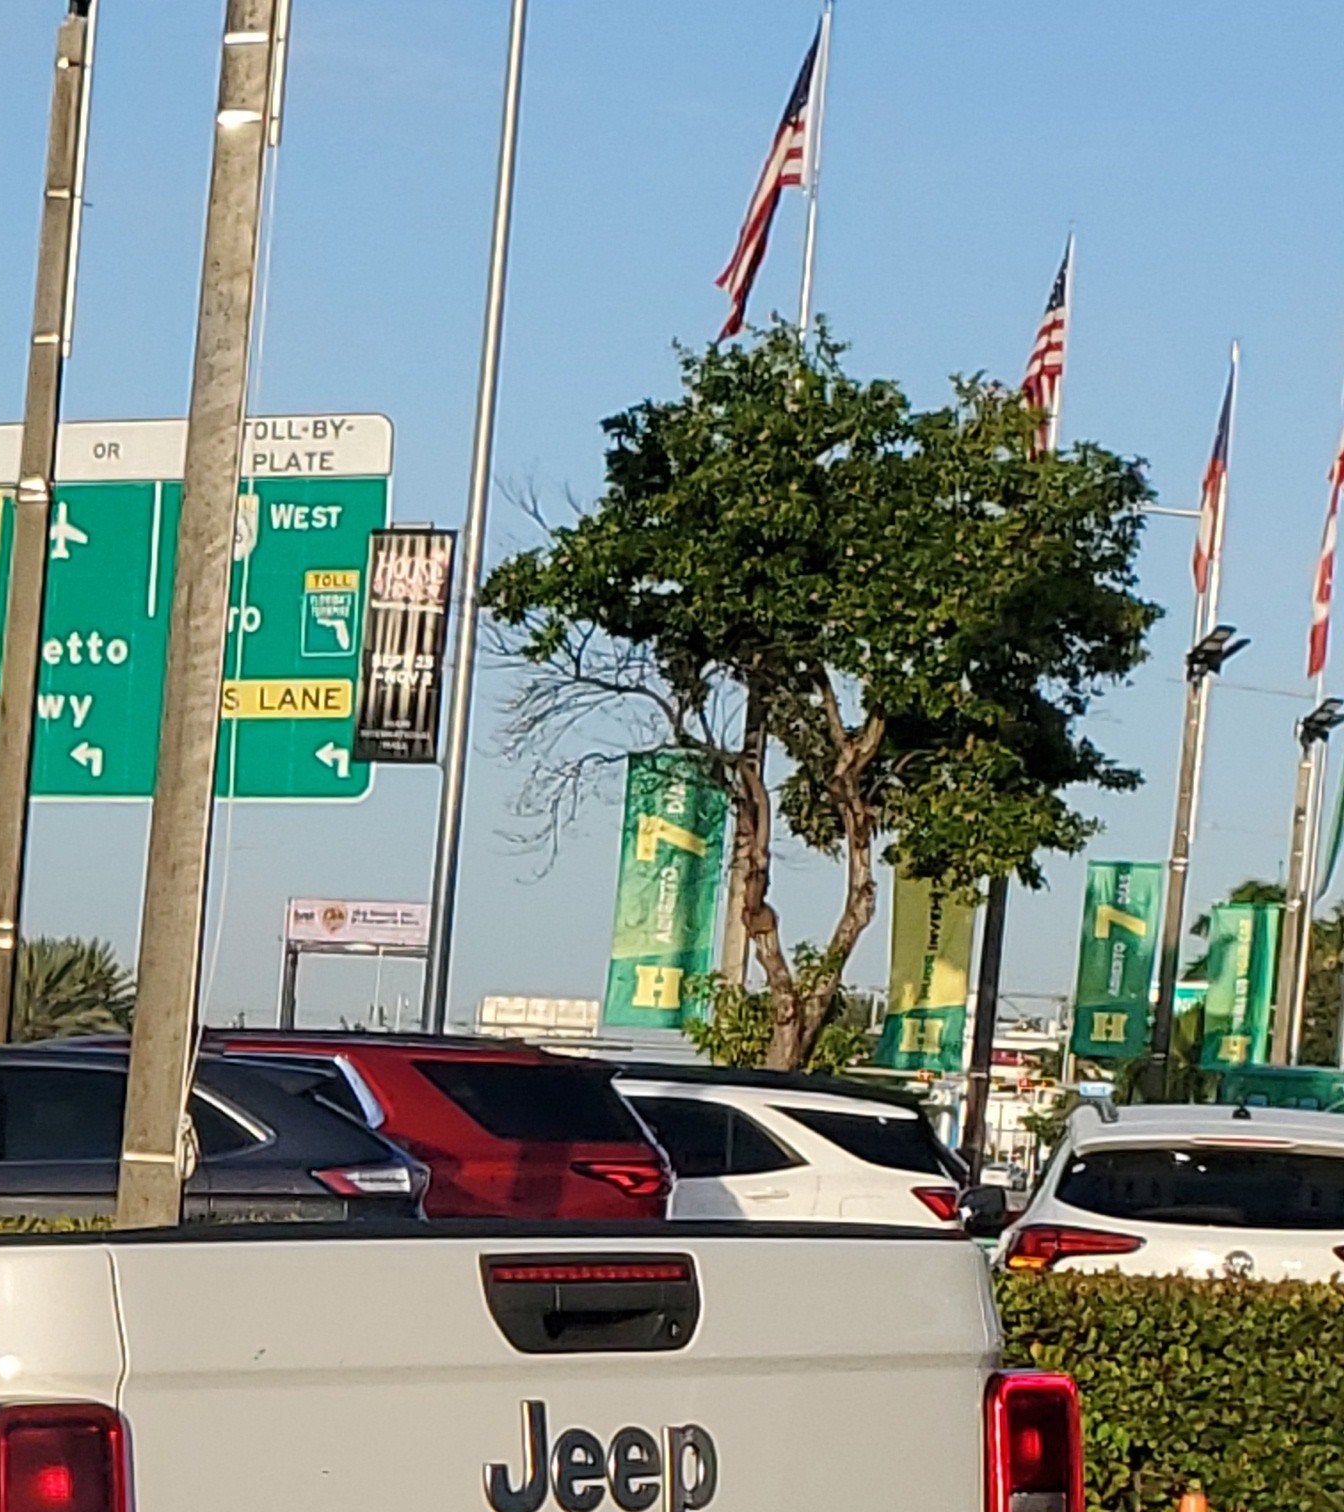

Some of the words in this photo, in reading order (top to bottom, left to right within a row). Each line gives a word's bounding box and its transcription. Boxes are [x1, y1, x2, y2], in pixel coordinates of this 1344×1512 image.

[94, 443, 120, 459] OR
[252, 451, 334, 472] PLATE
[270, 503, 343, 530] WEST
[314, 574, 352, 587] TOLL
[259, 686, 342, 711] LANE
[636, 813, 707, 862] 7
[1094, 903, 1146, 938] 7
[632, 964, 684, 1009] H
[1089, 1012, 1128, 1043] H
